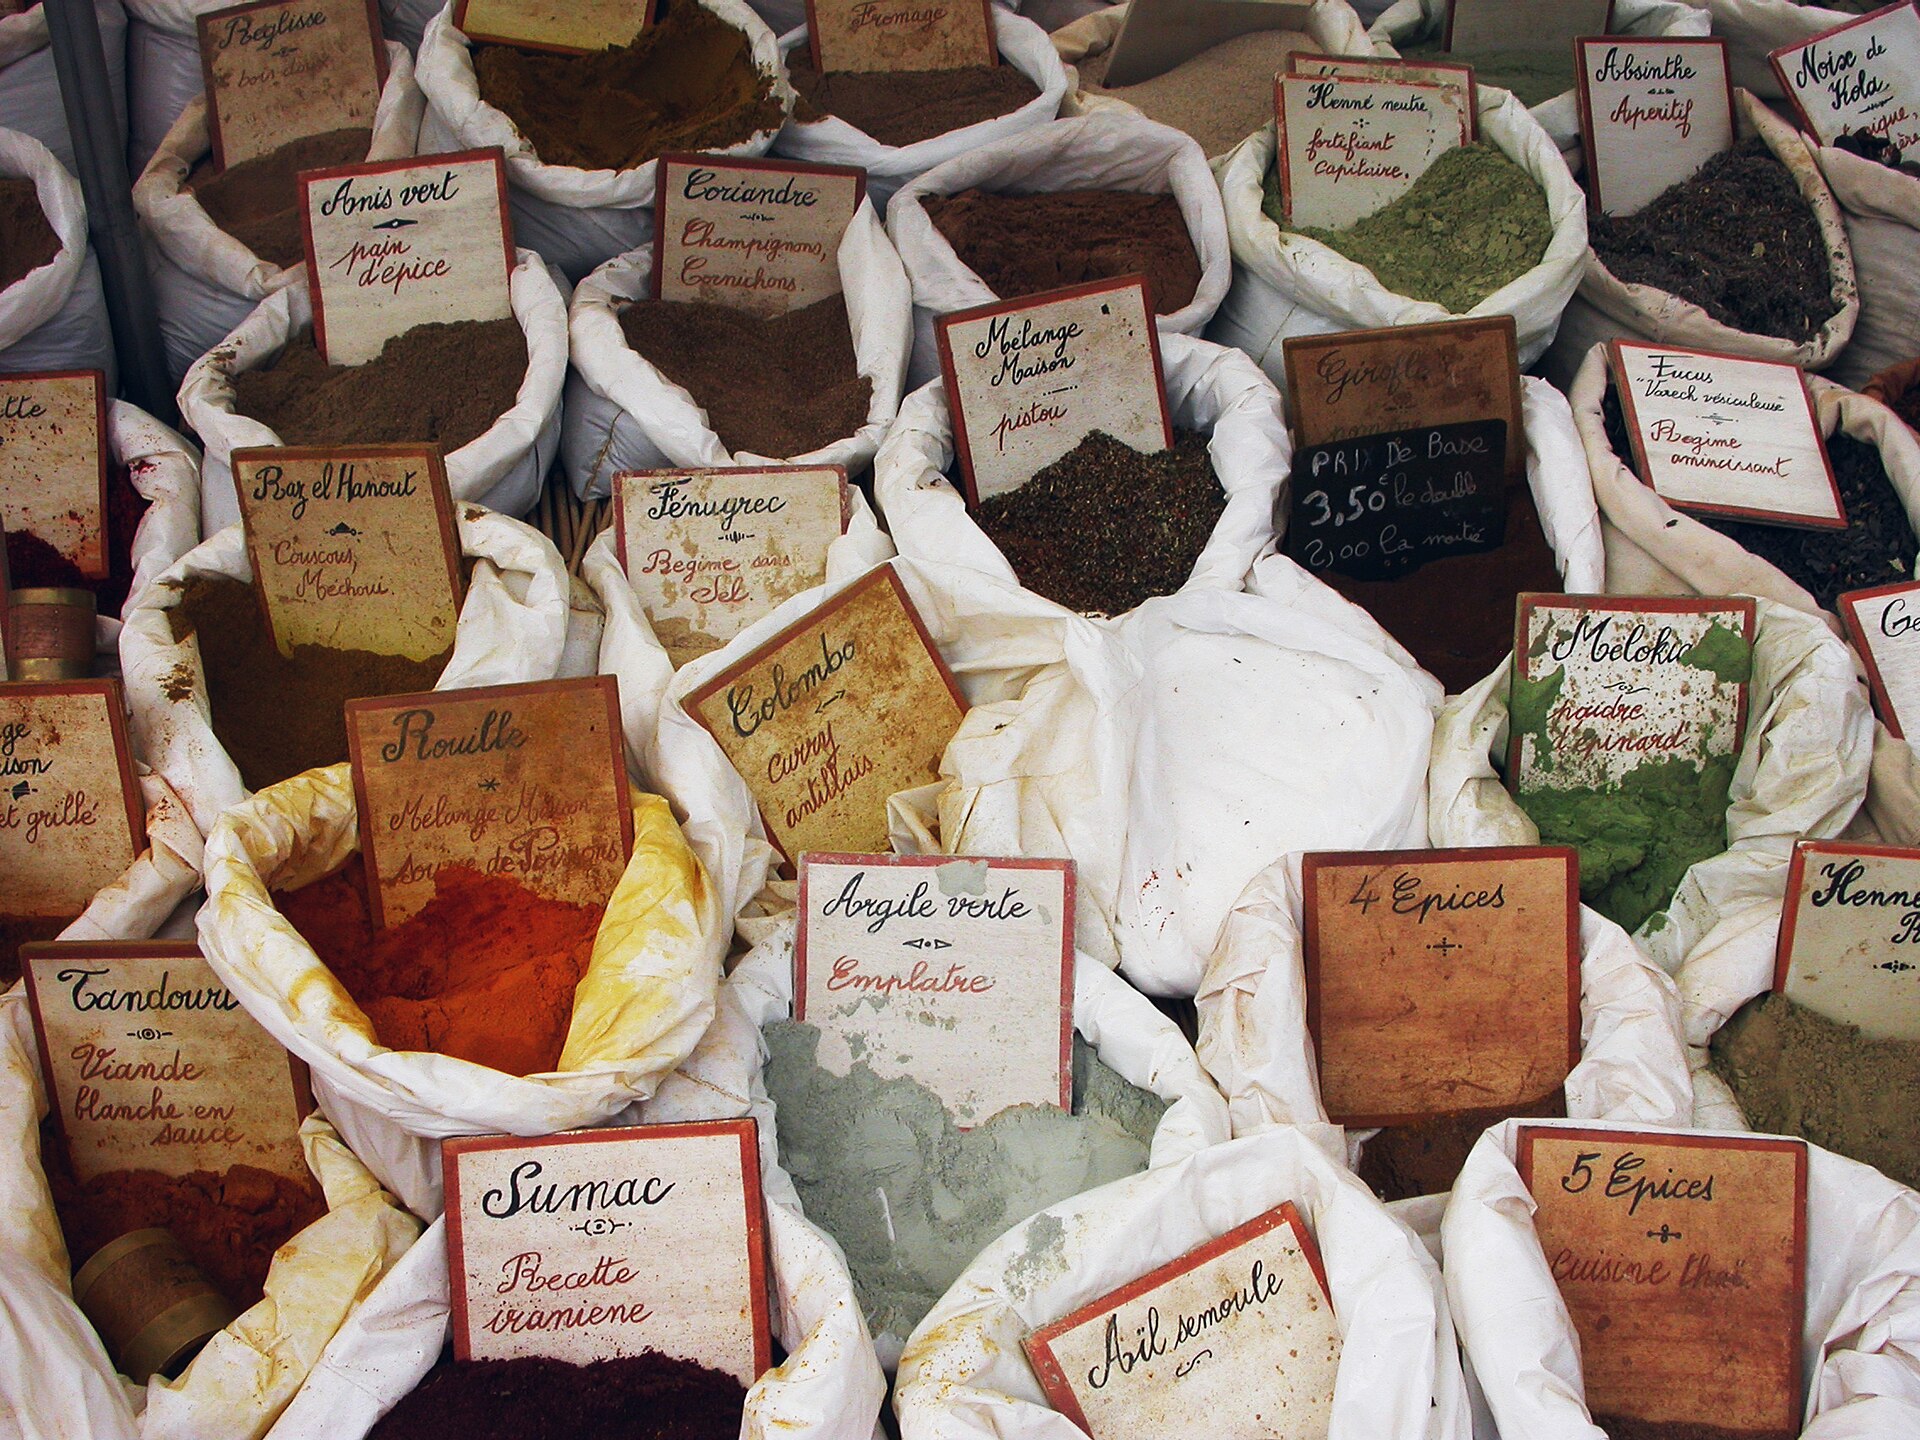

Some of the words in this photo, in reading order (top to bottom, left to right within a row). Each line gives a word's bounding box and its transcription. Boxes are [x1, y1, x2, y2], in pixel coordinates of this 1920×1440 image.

[851, 1, 948, 33] Fromage
[1596, 53, 1698, 82] Absinthe
[1796, 45, 1856, 88] Noix
[1866, 35, 1887, 61] de
[1306, 83, 1374, 110] Henné
[1381, 94, 1428, 113] neutre
[1828, 69, 1888, 110] Kola
[1610, 96, 1694, 138] Aperitif
[1305, 127, 1396, 162] fortifiant
[321, 178, 393, 217] Anis
[400, 170, 460, 205] vert
[683, 168, 821, 208] Coriandre
[330, 235, 411, 270] pain
[359, 254, 452, 294] d'épice
[975, 316, 1084, 359] Mélange
[990, 352, 1076, 387] Maison
[1648, 355, 1713, 384] Fucus
[0, 395, 47, 419] tte
[990, 402, 1068, 451] pistou
[1427, 432, 1489, 459] Base
[1671, 451, 1793, 478] amincissant
[253, 466, 309, 520] Raz
[312, 463, 334, 498] el
[336, 463, 417, 503] Hanout
[648, 477, 787, 531] Fénugrec
[1394, 472, 1414, 506] le
[750, 554, 791, 569] sans
[1304, 539, 1370, 568] 2,00
[727, 633, 856, 738] Colombo
[1547, 694, 1645, 722] poudre
[381, 709, 530, 763] Rouille
[0, 757, 53, 776] ison
[26, 790, 99, 843] grillé
[389, 794, 499, 842] Mélange
[486, 846, 515, 876] de
[822, 872, 937, 934] Argile
[947, 887, 1032, 921] verte
[1349, 874, 1380, 915] 4
[1391, 871, 1506, 924] Epices
[57, 967, 240, 1012] Tandouri
[70, 1043, 206, 1082] Viande
[74, 1085, 184, 1121] blanche
[194, 1104, 234, 1120] en
[150, 1122, 245, 1146] sauce
[481, 1160, 677, 1219] Sumac
[1561, 1153, 1602, 1194] 5
[1605, 1151, 1713, 1216] Epices
[497, 1251, 641, 1294] Recette
[1171, 1259, 1284, 1352] semoule
